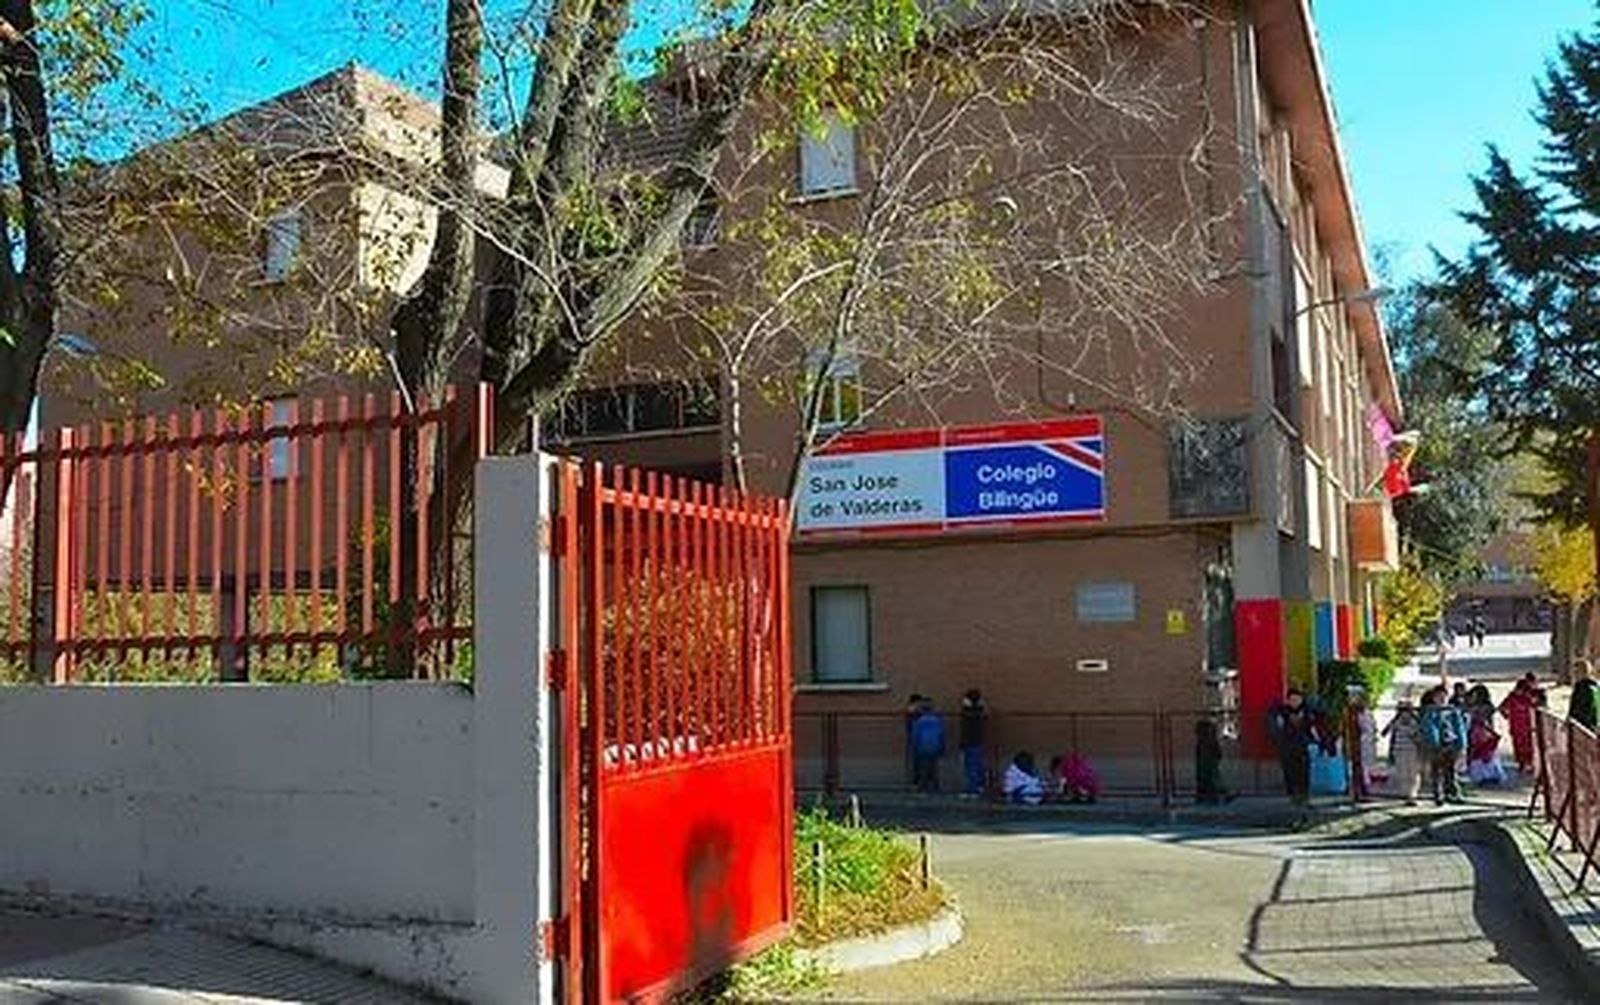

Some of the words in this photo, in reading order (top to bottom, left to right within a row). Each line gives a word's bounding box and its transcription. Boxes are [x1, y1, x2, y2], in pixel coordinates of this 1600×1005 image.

[977, 461, 1056, 485] Colegio
[809, 476, 847, 494] San
[810, 501, 835, 518] de
[839, 498, 923, 516] Valderas
